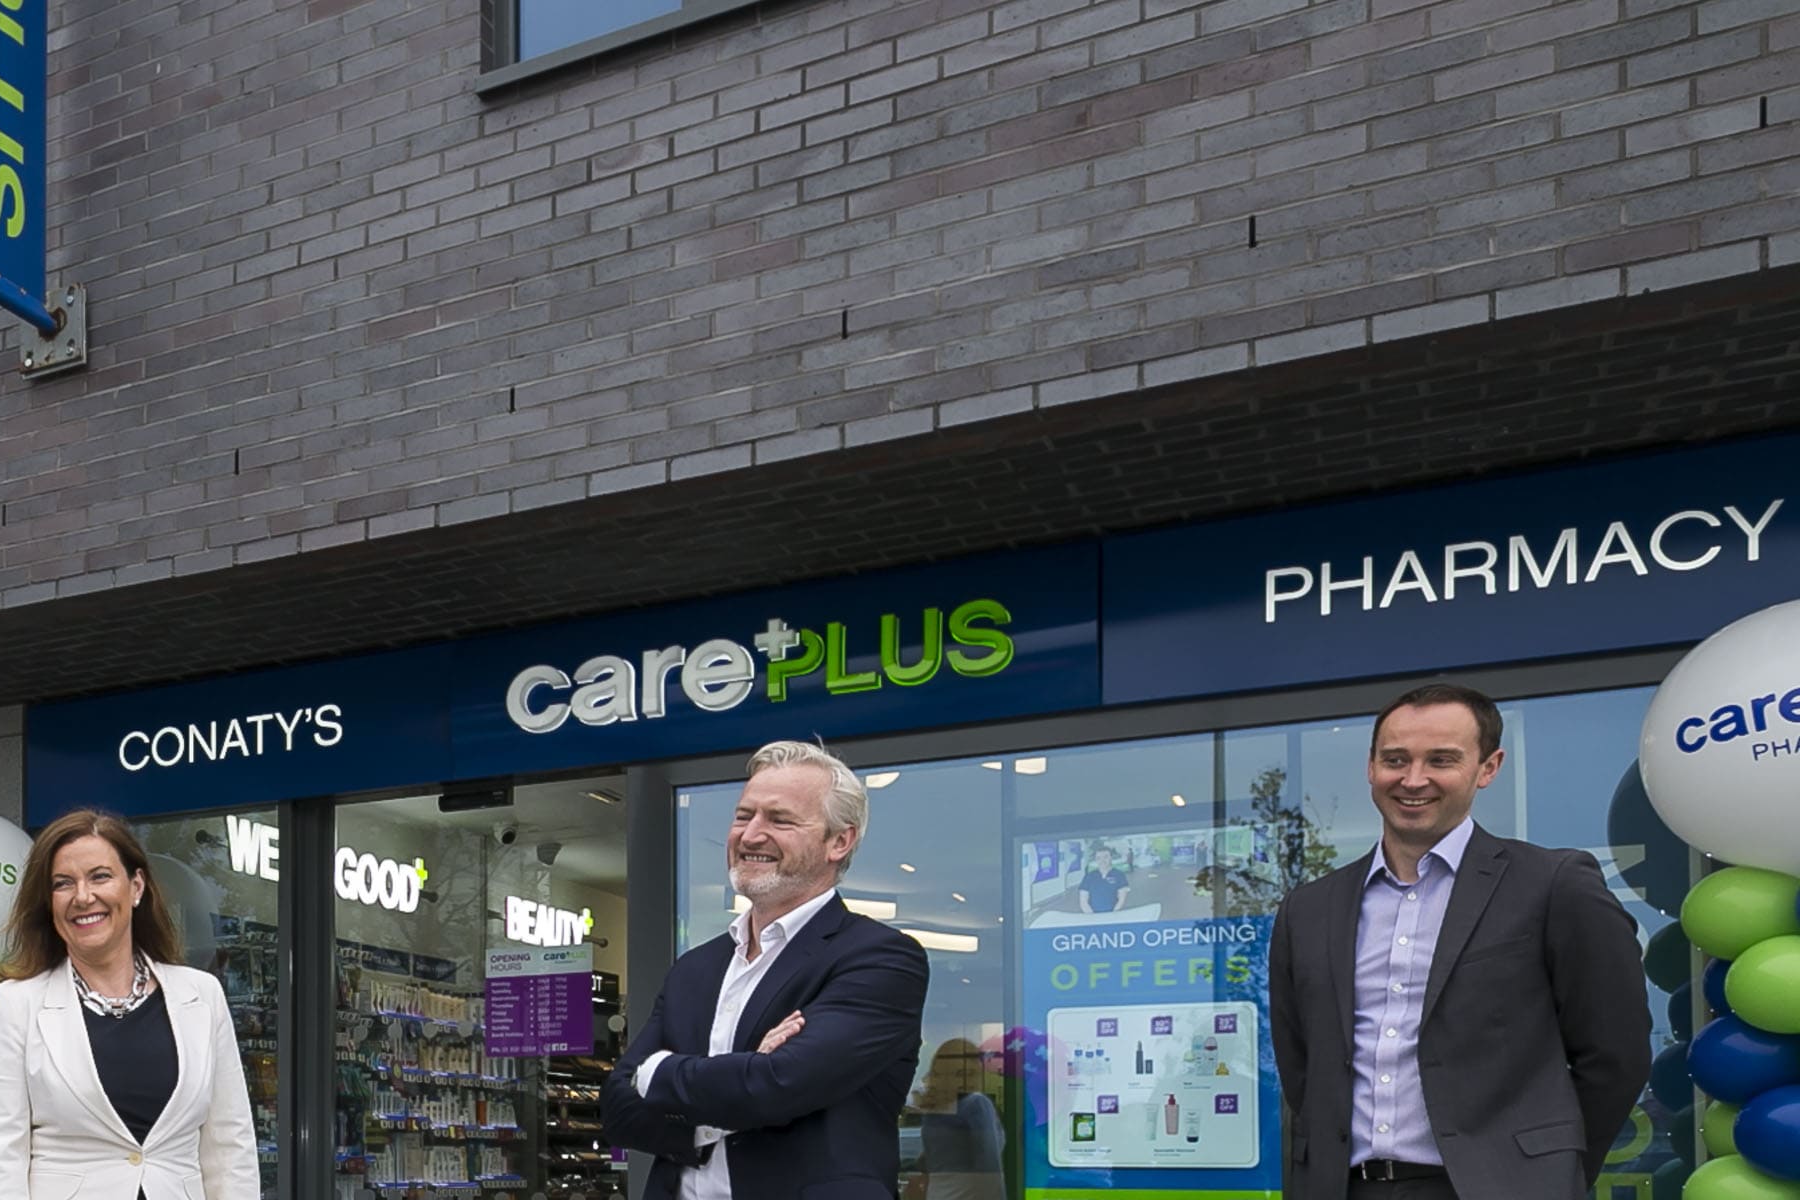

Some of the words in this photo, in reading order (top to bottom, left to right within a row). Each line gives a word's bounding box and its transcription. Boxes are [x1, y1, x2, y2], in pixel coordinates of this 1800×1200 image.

[1264, 499, 1785, 623] PHARMACY
[119, 704, 343, 771] CONATY'S
[1052, 930, 1136, 951] GRAND
[1143, 924, 1256, 947] OPENING
[1050, 955, 1250, 991] OFFERS
